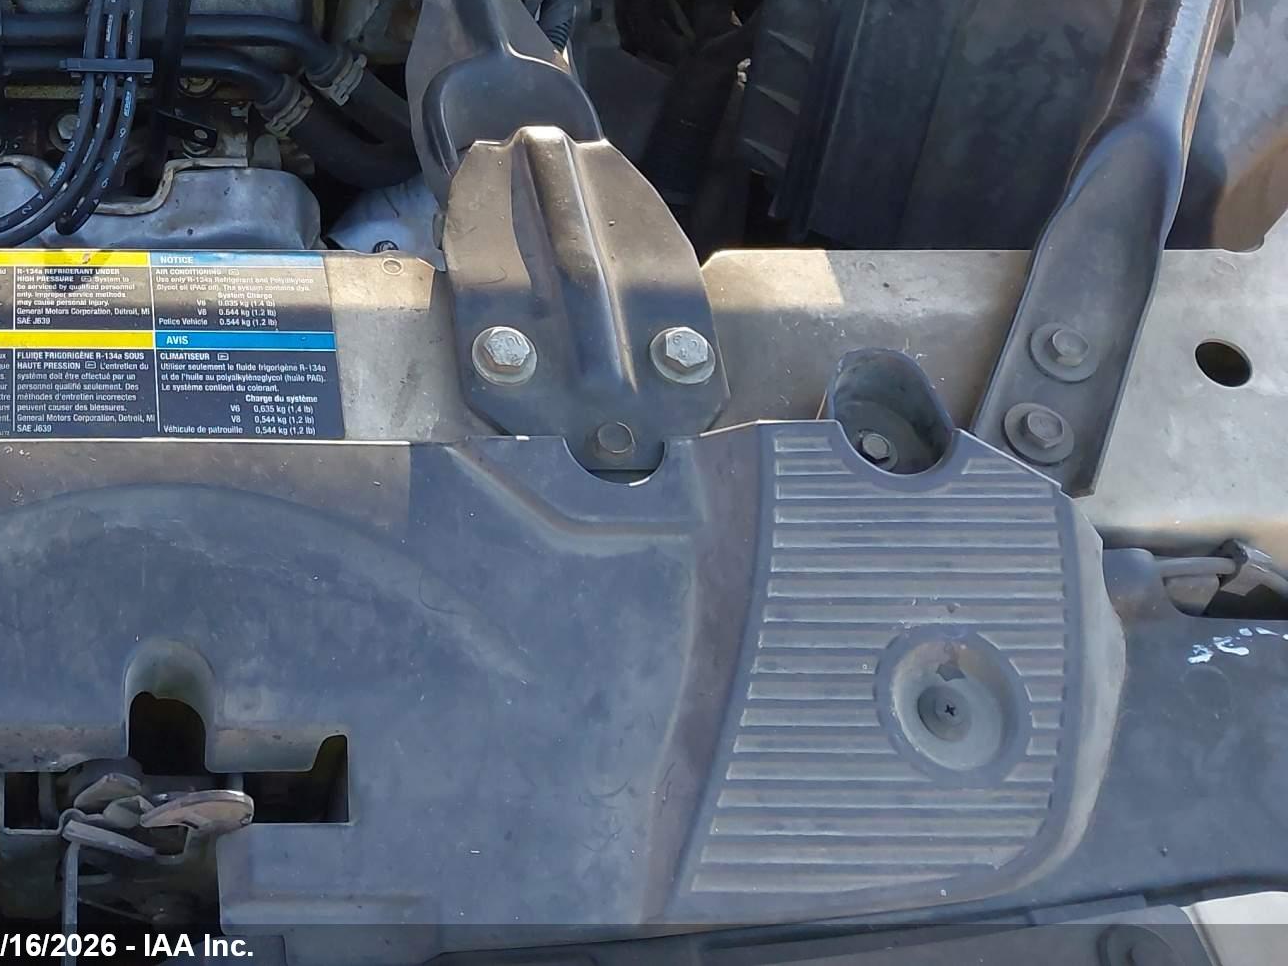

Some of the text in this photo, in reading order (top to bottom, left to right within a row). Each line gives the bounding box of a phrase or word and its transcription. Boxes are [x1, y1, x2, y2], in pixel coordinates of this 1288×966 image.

[161, 256, 193, 264] NOTICE
[17, 299, 109, 307] may cause personal injury.
[17, 307, 150, 316] General Motors Corporation, Detroit, MI
[17, 317, 51, 325] SAE J639
[159, 318, 180, 326] Police
[182, 318, 208, 326] Vehicle
[166, 336, 189, 345] AVIS
[17, 351, 144, 360] FLUIDE FRIGORIGÈNE R-134a SOUS
[100, 362, 149, 370] L'entretien du
[161, 363, 326, 372] Utiliser seulement le fluide frigorigène R-134a
[17, 372, 136, 381] système doit être effectué par un
[162, 373, 169, 382] et
[170, 373, 180, 382] de
[181, 373, 204, 382] l'huile
[205, 373, 215, 382] au
[284, 374, 305, 383] (huile
[307, 374, 326, 383] PAG).
[17, 383, 139, 392] personnel qualifié seulement. Des
[162, 384, 280, 393] Le système contient du colorant.
[17, 393, 137, 401] méthodes d'entretien incorrectes
[246, 395, 318, 403] Charge du système
[17, 404, 127, 412] peuvent causer des blessures.
[254, 405, 275, 414] 0,635
[276, 405, 286, 414] kg
[288, 405, 302, 414] (1,4
[304, 405, 313, 414] lb)
[17, 414, 155, 423] General Motors Corporation, Detroit, MI
[231, 415, 314, 424] V8 0,544 kg (1,2 lb)
[17, 425, 32, 433] SAE
[34, 425, 52, 433] J639
[164, 425, 316, 435] Véhicule de patrouille 0,544 kg (1,2 lb)
